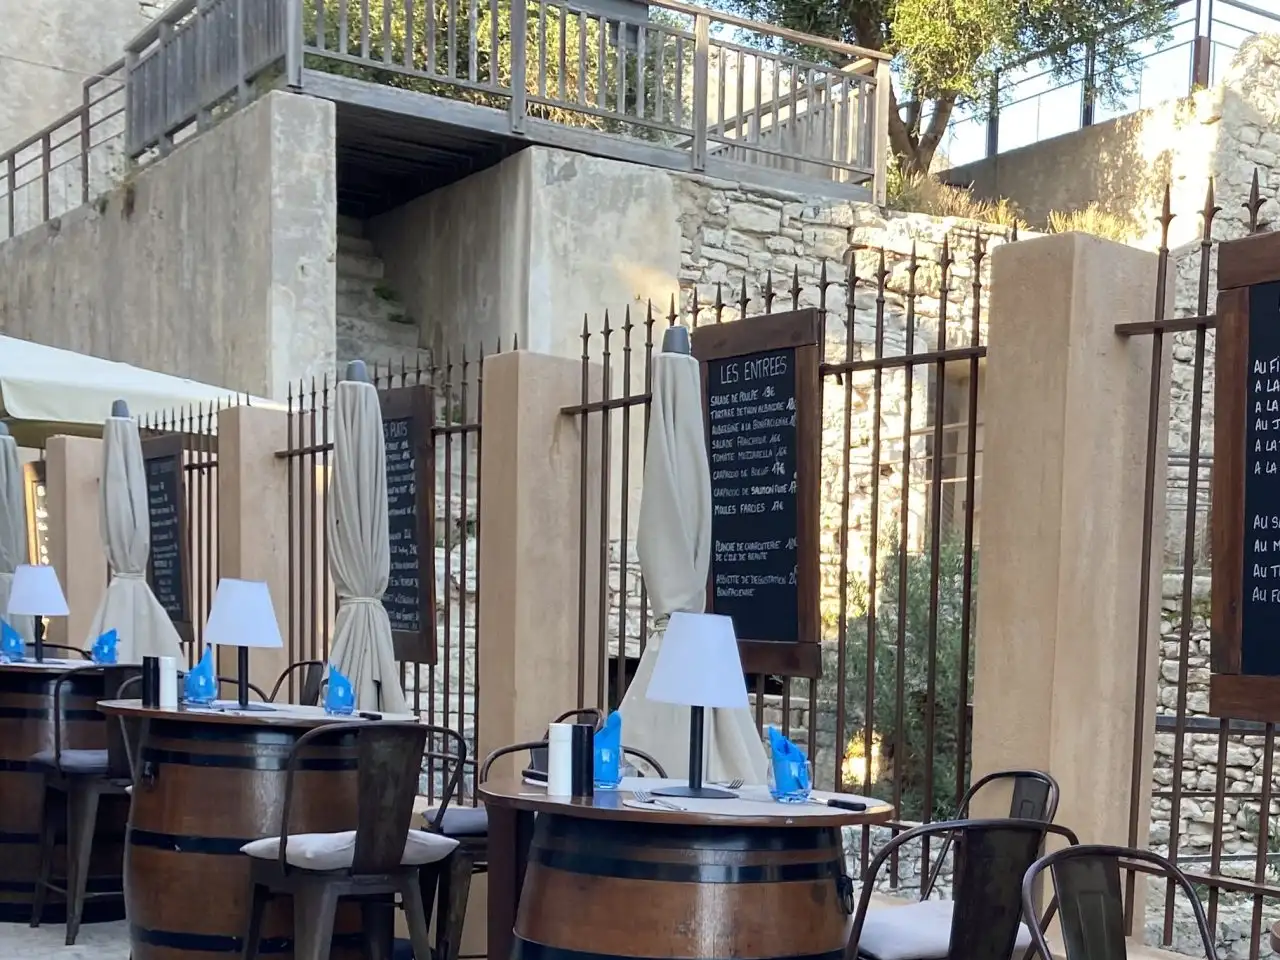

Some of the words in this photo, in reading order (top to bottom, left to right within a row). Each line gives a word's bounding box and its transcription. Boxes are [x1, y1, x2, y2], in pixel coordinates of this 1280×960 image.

[720, 362, 738, 384] LES
[744, 355, 787, 381] ENTREES
[1254, 359, 1267, 375] AU
[1255, 380, 1262, 393] A
[1267, 379, 1280, 393] LA
[1256, 401, 1262, 414] A
[1267, 399, 1279, 413] LA
[1256, 418, 1268, 431] AU
[1255, 439, 1262, 452] A
[1266, 439, 1278, 452] LA
[1254, 461, 1261, 475] A
[1266, 460, 1277, 474] LA
[1254, 514, 1268, 529] AU
[1254, 540, 1267, 552] AU
[1254, 564, 1268, 578] AU
[1252, 587, 1267, 603] AU
